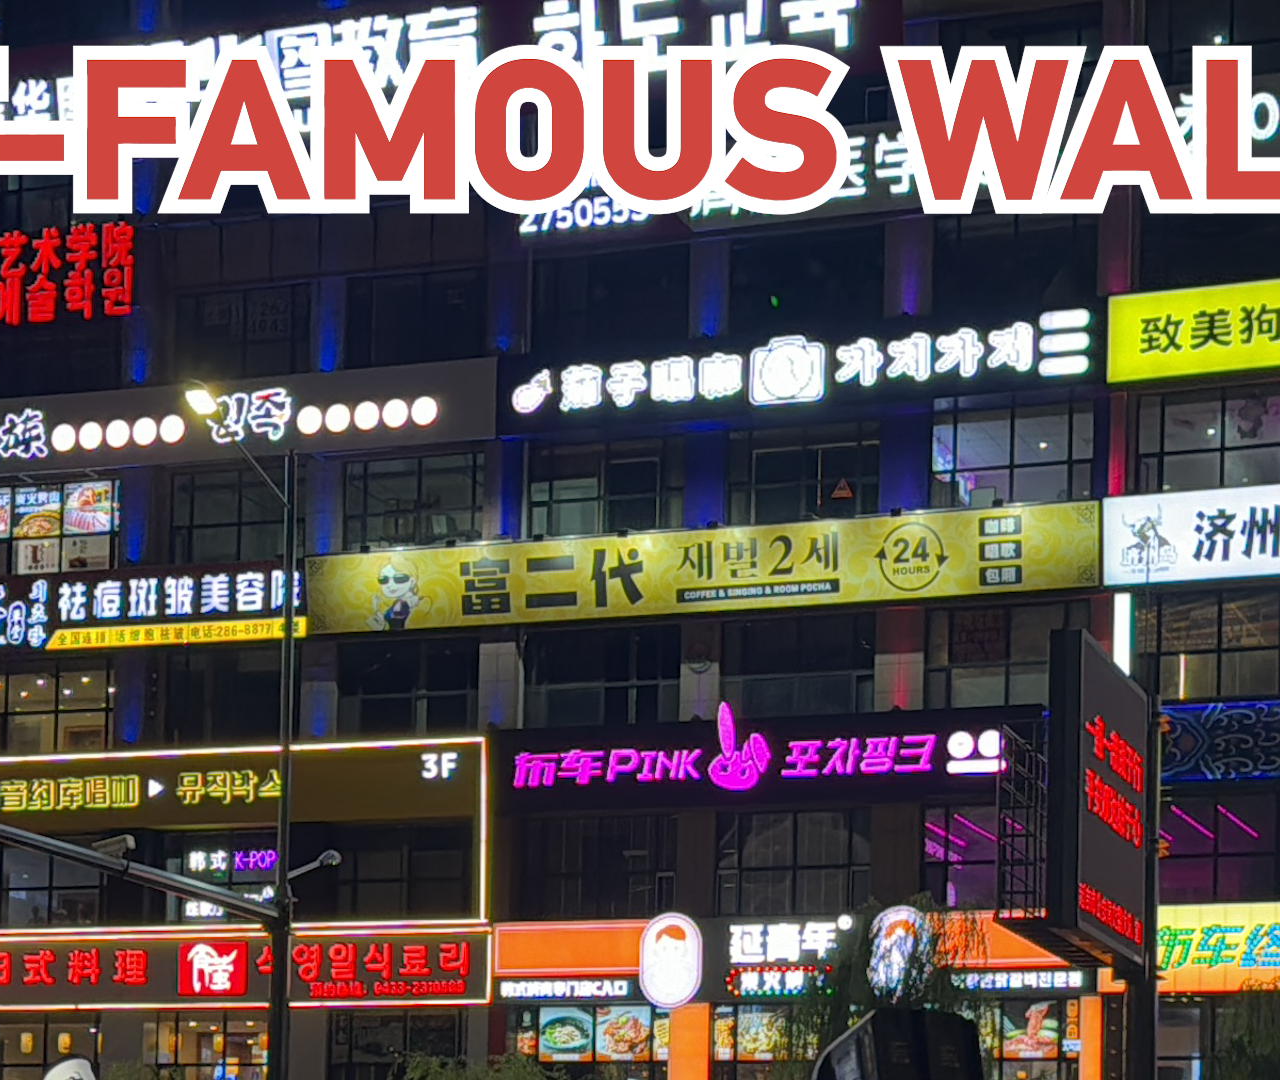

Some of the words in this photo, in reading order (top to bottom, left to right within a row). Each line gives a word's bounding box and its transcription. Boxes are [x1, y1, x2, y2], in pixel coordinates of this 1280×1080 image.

[676, 530, 842, 582] 재벌2세
[892, 536, 931, 564] 24
[458, 548, 645, 619] 富二代
[892, 564, 931, 577] HOURS
[419, 751, 458, 780] 3F
[232, 848, 281, 871] K-POP
